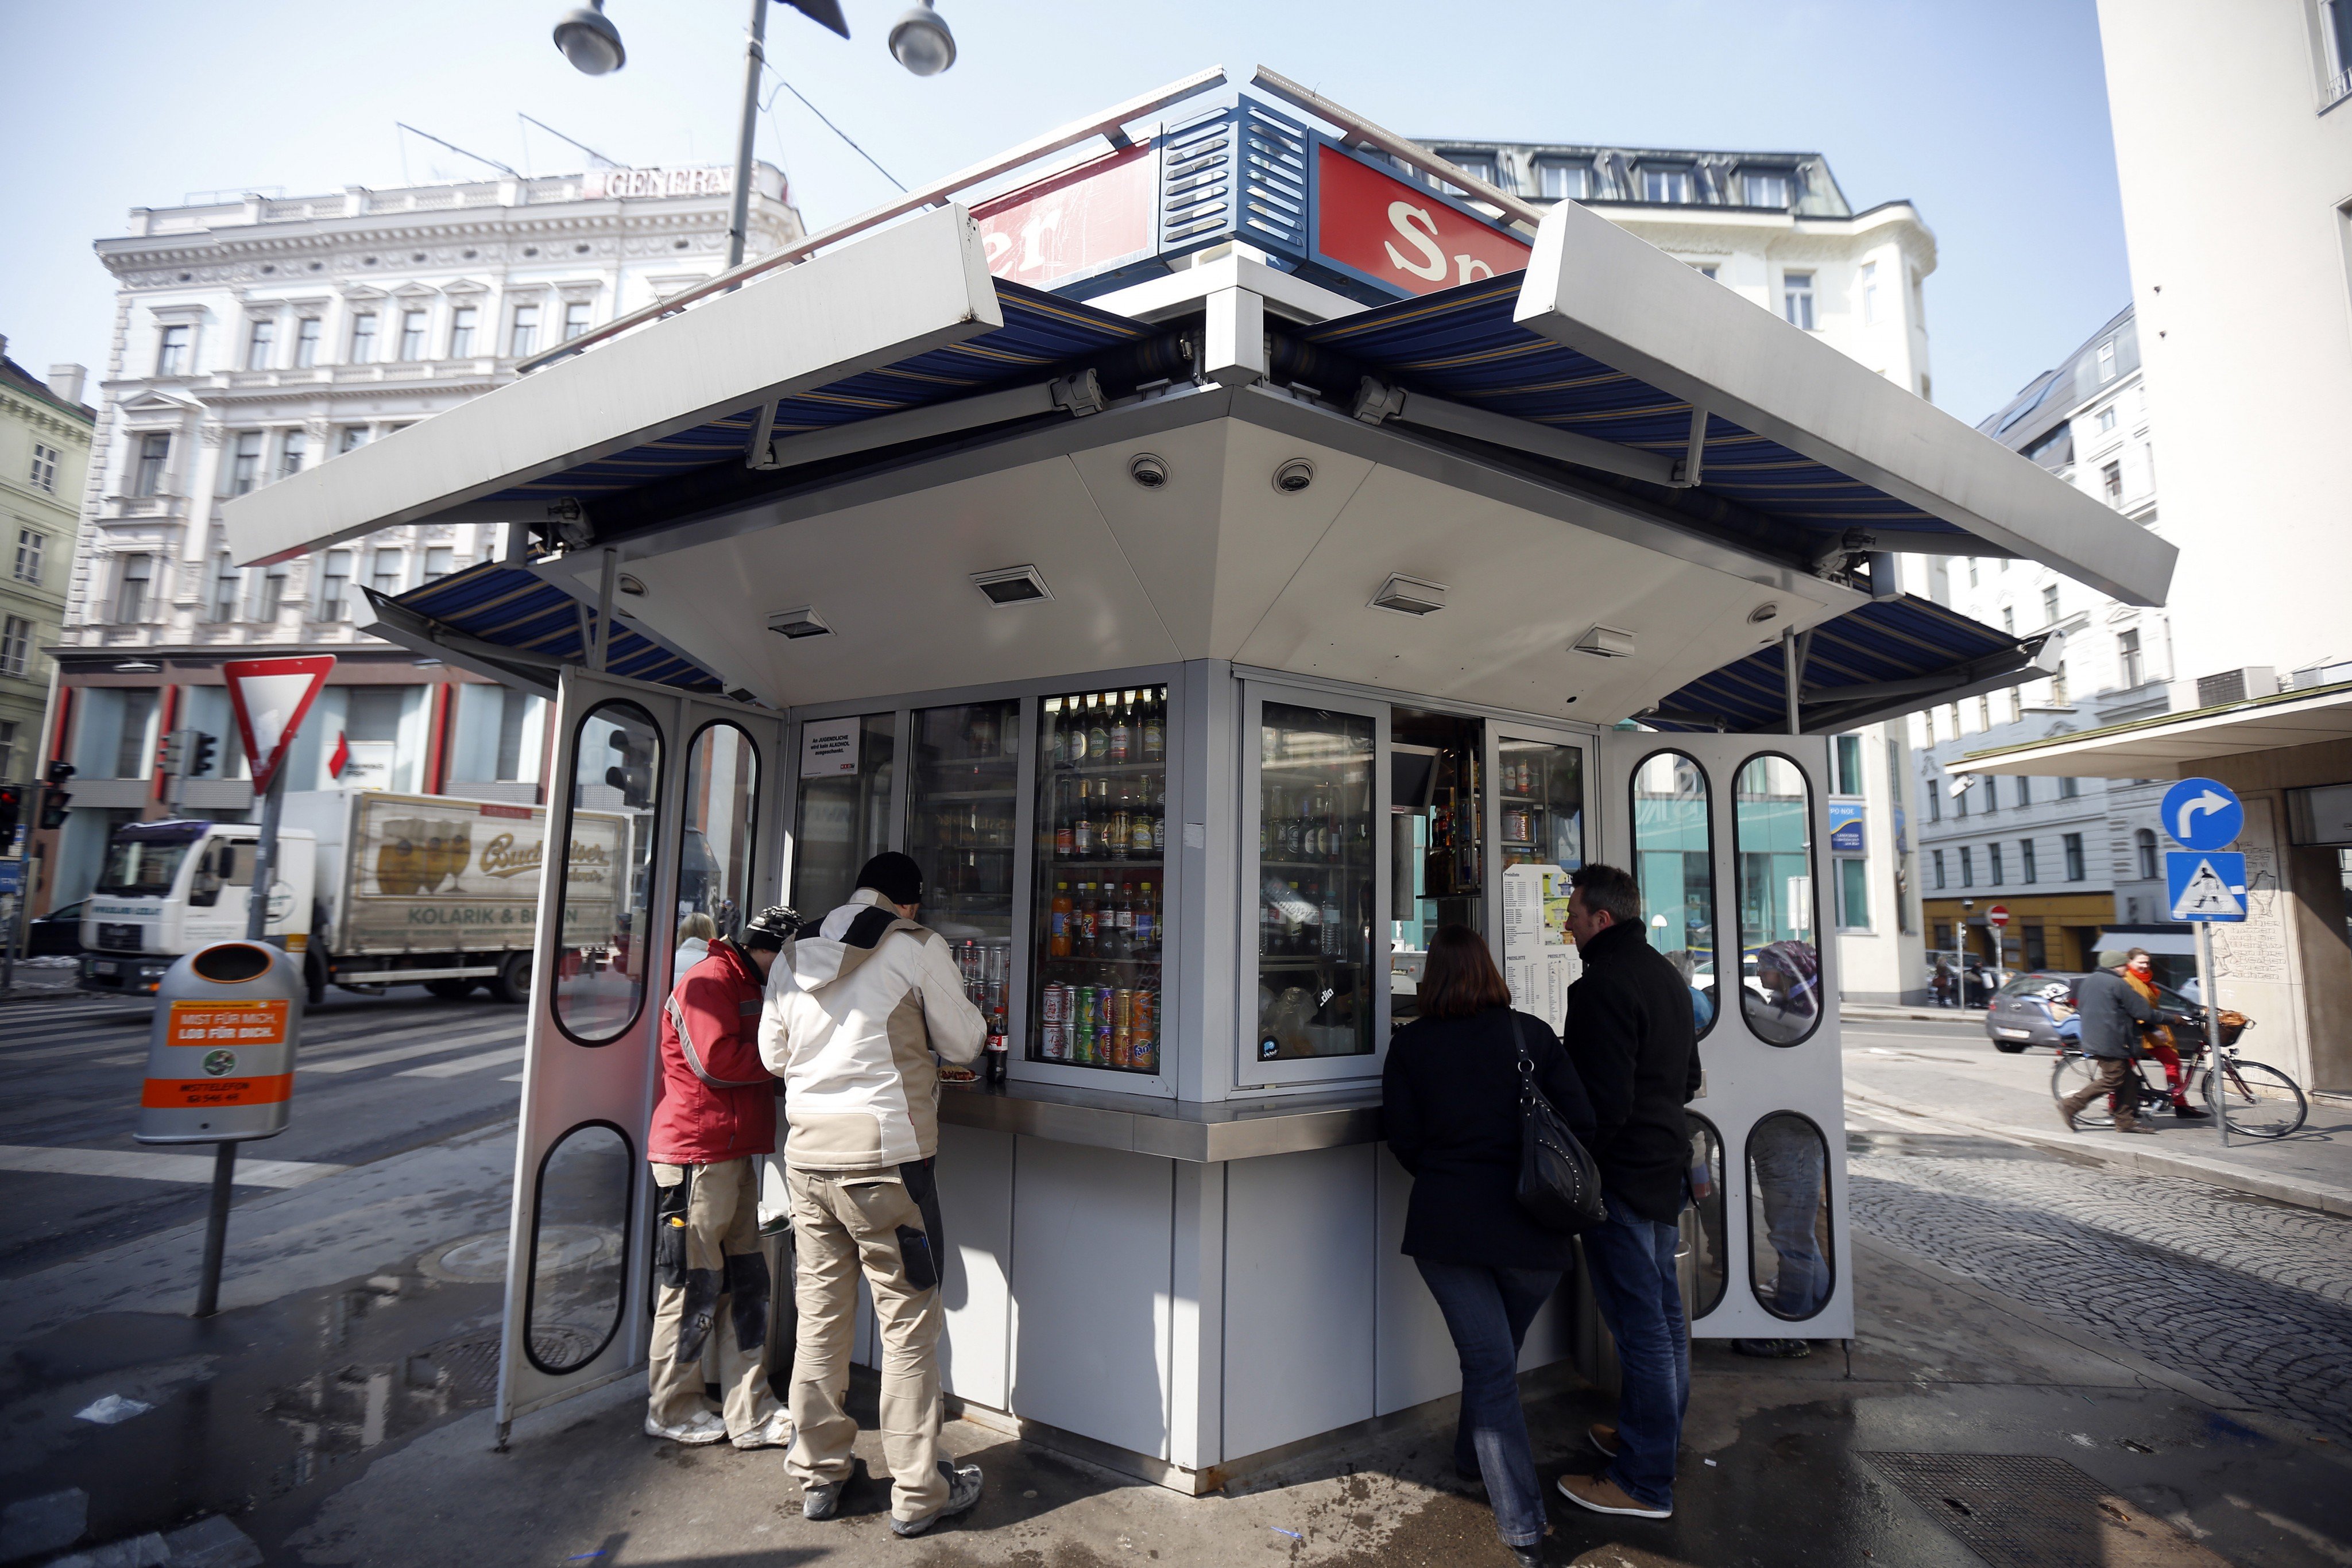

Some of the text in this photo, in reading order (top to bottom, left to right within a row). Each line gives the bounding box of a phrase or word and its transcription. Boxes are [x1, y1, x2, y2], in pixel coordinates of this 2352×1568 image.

[818, 735, 849, 743] JUGENDLICHE
[479, 833, 610, 872] Budiser
[409, 908, 497, 923] KOLARIK
[501, 909, 513, 923] &
[180, 1014, 212, 1025] MIST
[213, 1012, 240, 1024] FÜR
[178, 1028, 206, 1039] LOB
[207, 1025, 236, 1039] FÜR
[180, 1082, 250, 1092] MISTTELEFON
